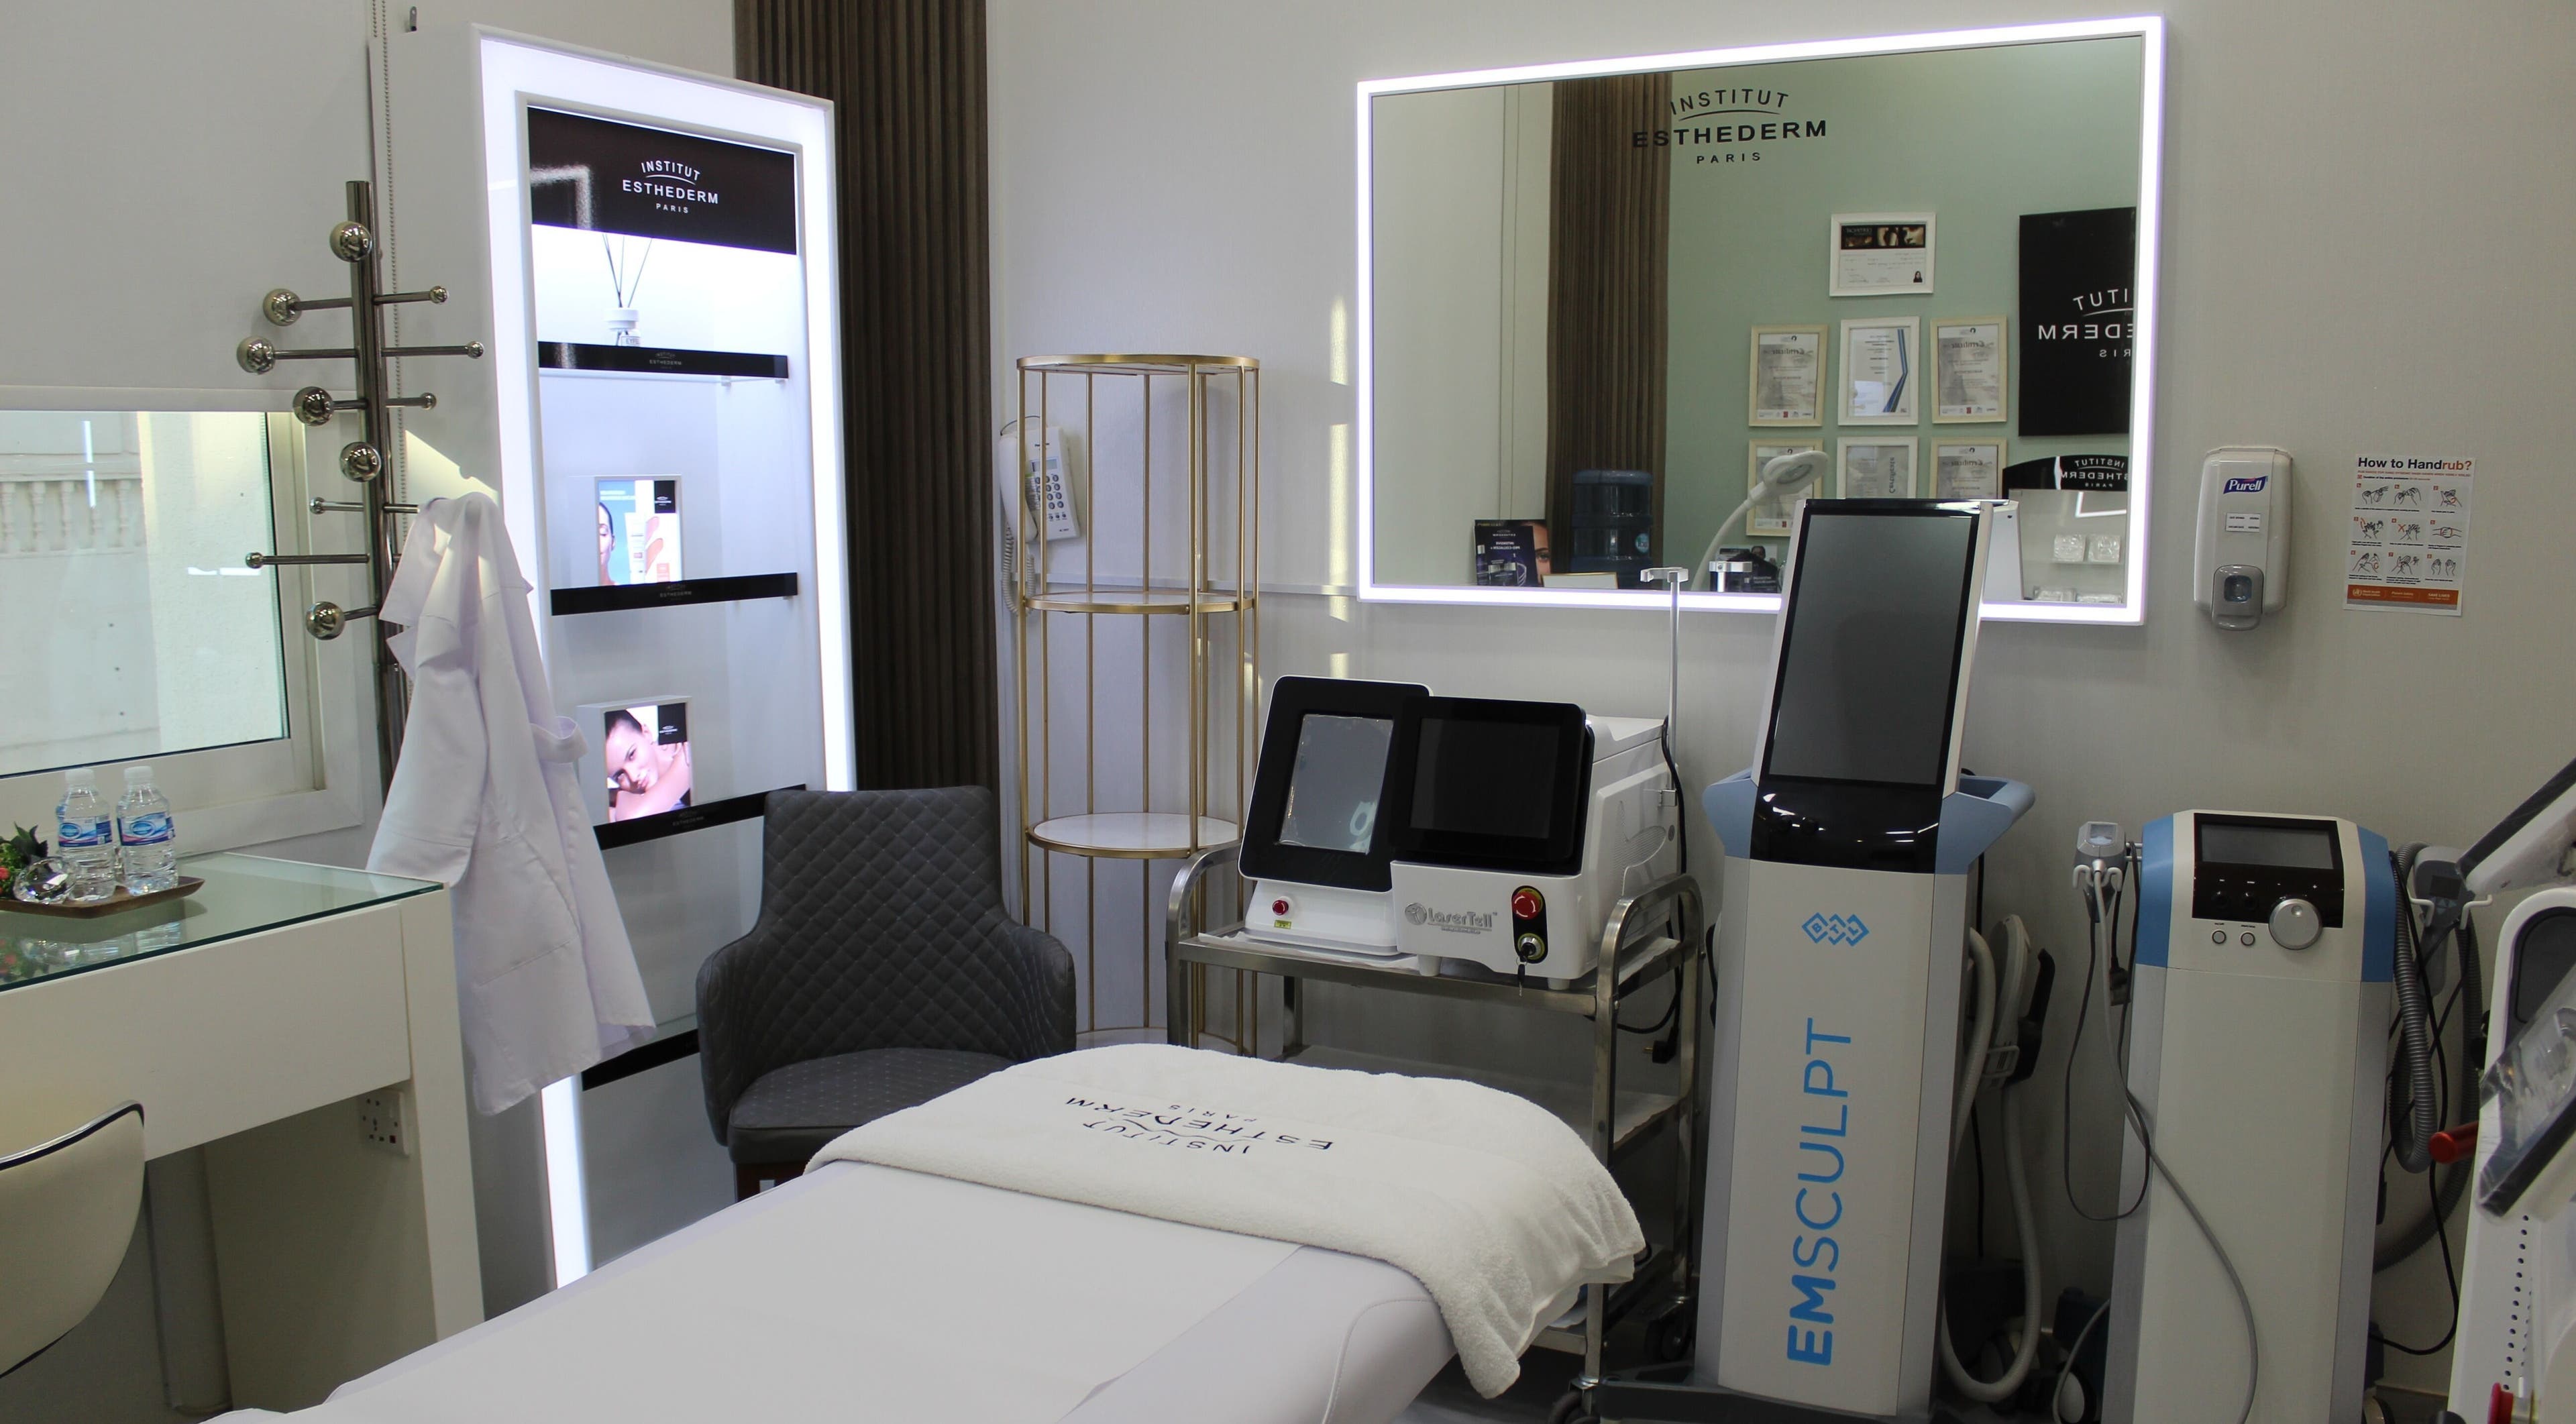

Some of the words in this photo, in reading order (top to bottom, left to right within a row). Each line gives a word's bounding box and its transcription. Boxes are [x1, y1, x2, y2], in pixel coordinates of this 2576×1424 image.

[1670, 89, 1789, 115] INSTITUT
[1633, 120, 1826, 148] ESTHEDERM
[1697, 152, 1761, 164] PARIS
[641, 160, 700, 181] INSTITUT
[622, 179, 719, 204] ESTHEDERM
[655, 203, 689, 213] PARIS
[2358, 457, 2387, 468] How
[2391, 458, 2404, 469] to
[2408, 459, 2472, 470] Handrub?
[2229, 479, 2263, 491] Purell
[1065, 1097, 1334, 1151] ESTHEDERM
[1170, 1103, 1258, 1122] PARIS
[1083, 1120, 1251, 1155] INSTITUT
[1786, 1017, 1851, 1366] EMSCULPT
